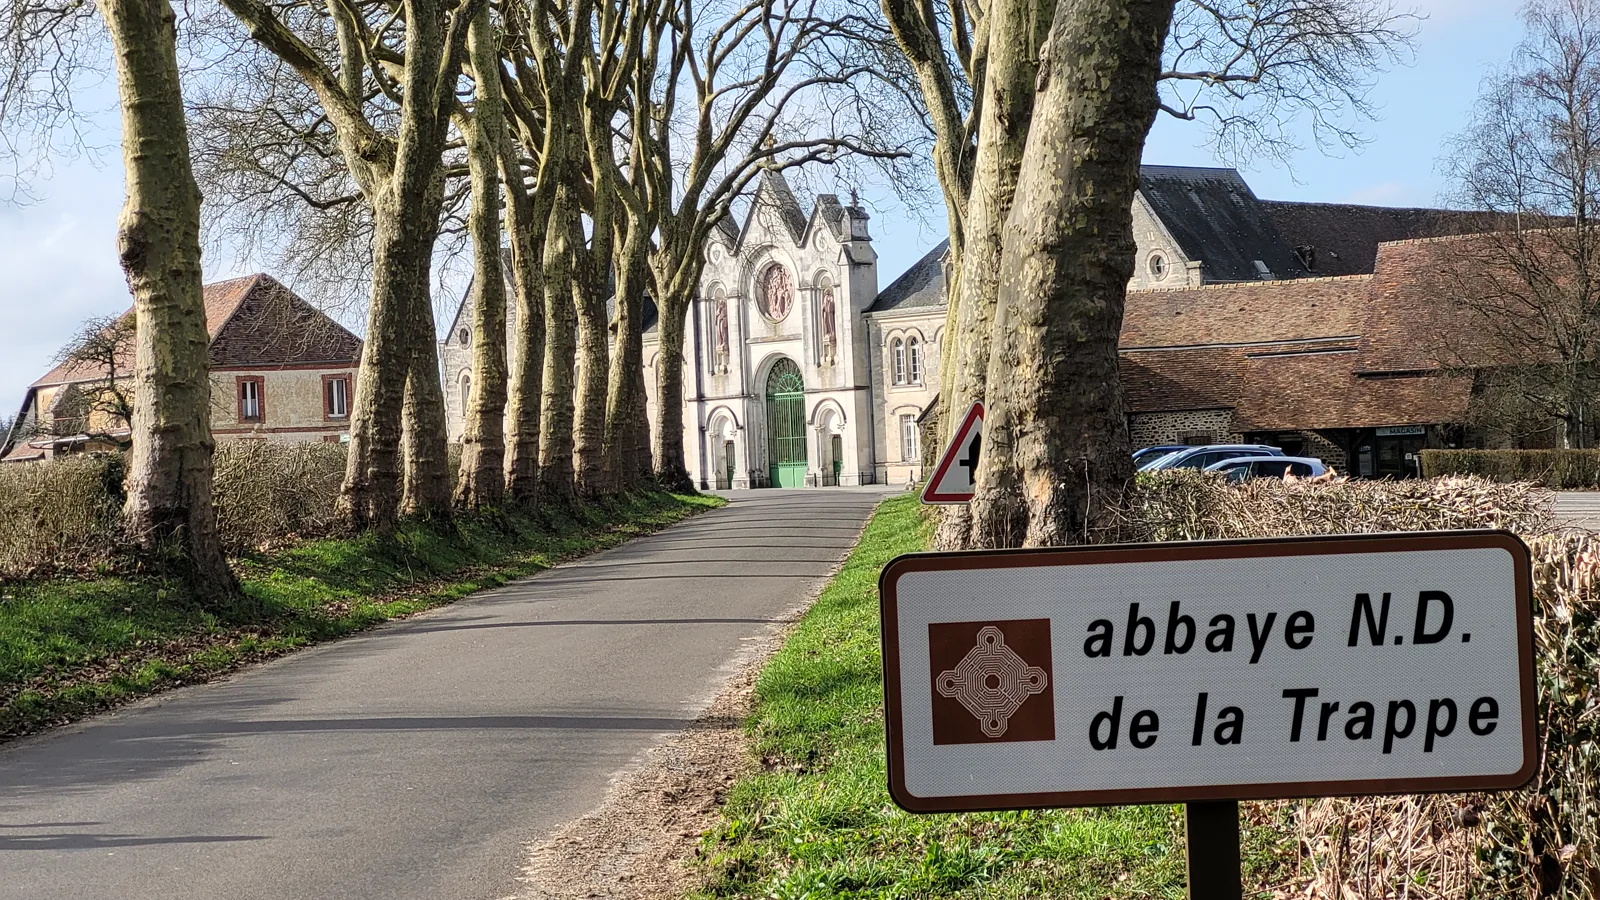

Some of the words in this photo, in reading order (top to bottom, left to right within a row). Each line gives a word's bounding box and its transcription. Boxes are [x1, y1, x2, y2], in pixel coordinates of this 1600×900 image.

[1083, 600, 1315, 665] abbaye
[1347, 590, 1472, 648] N.D.
[1088, 695, 1160, 751] de
[1191, 691, 1245, 747] la
[1281, 687, 1500, 755] Trappe
